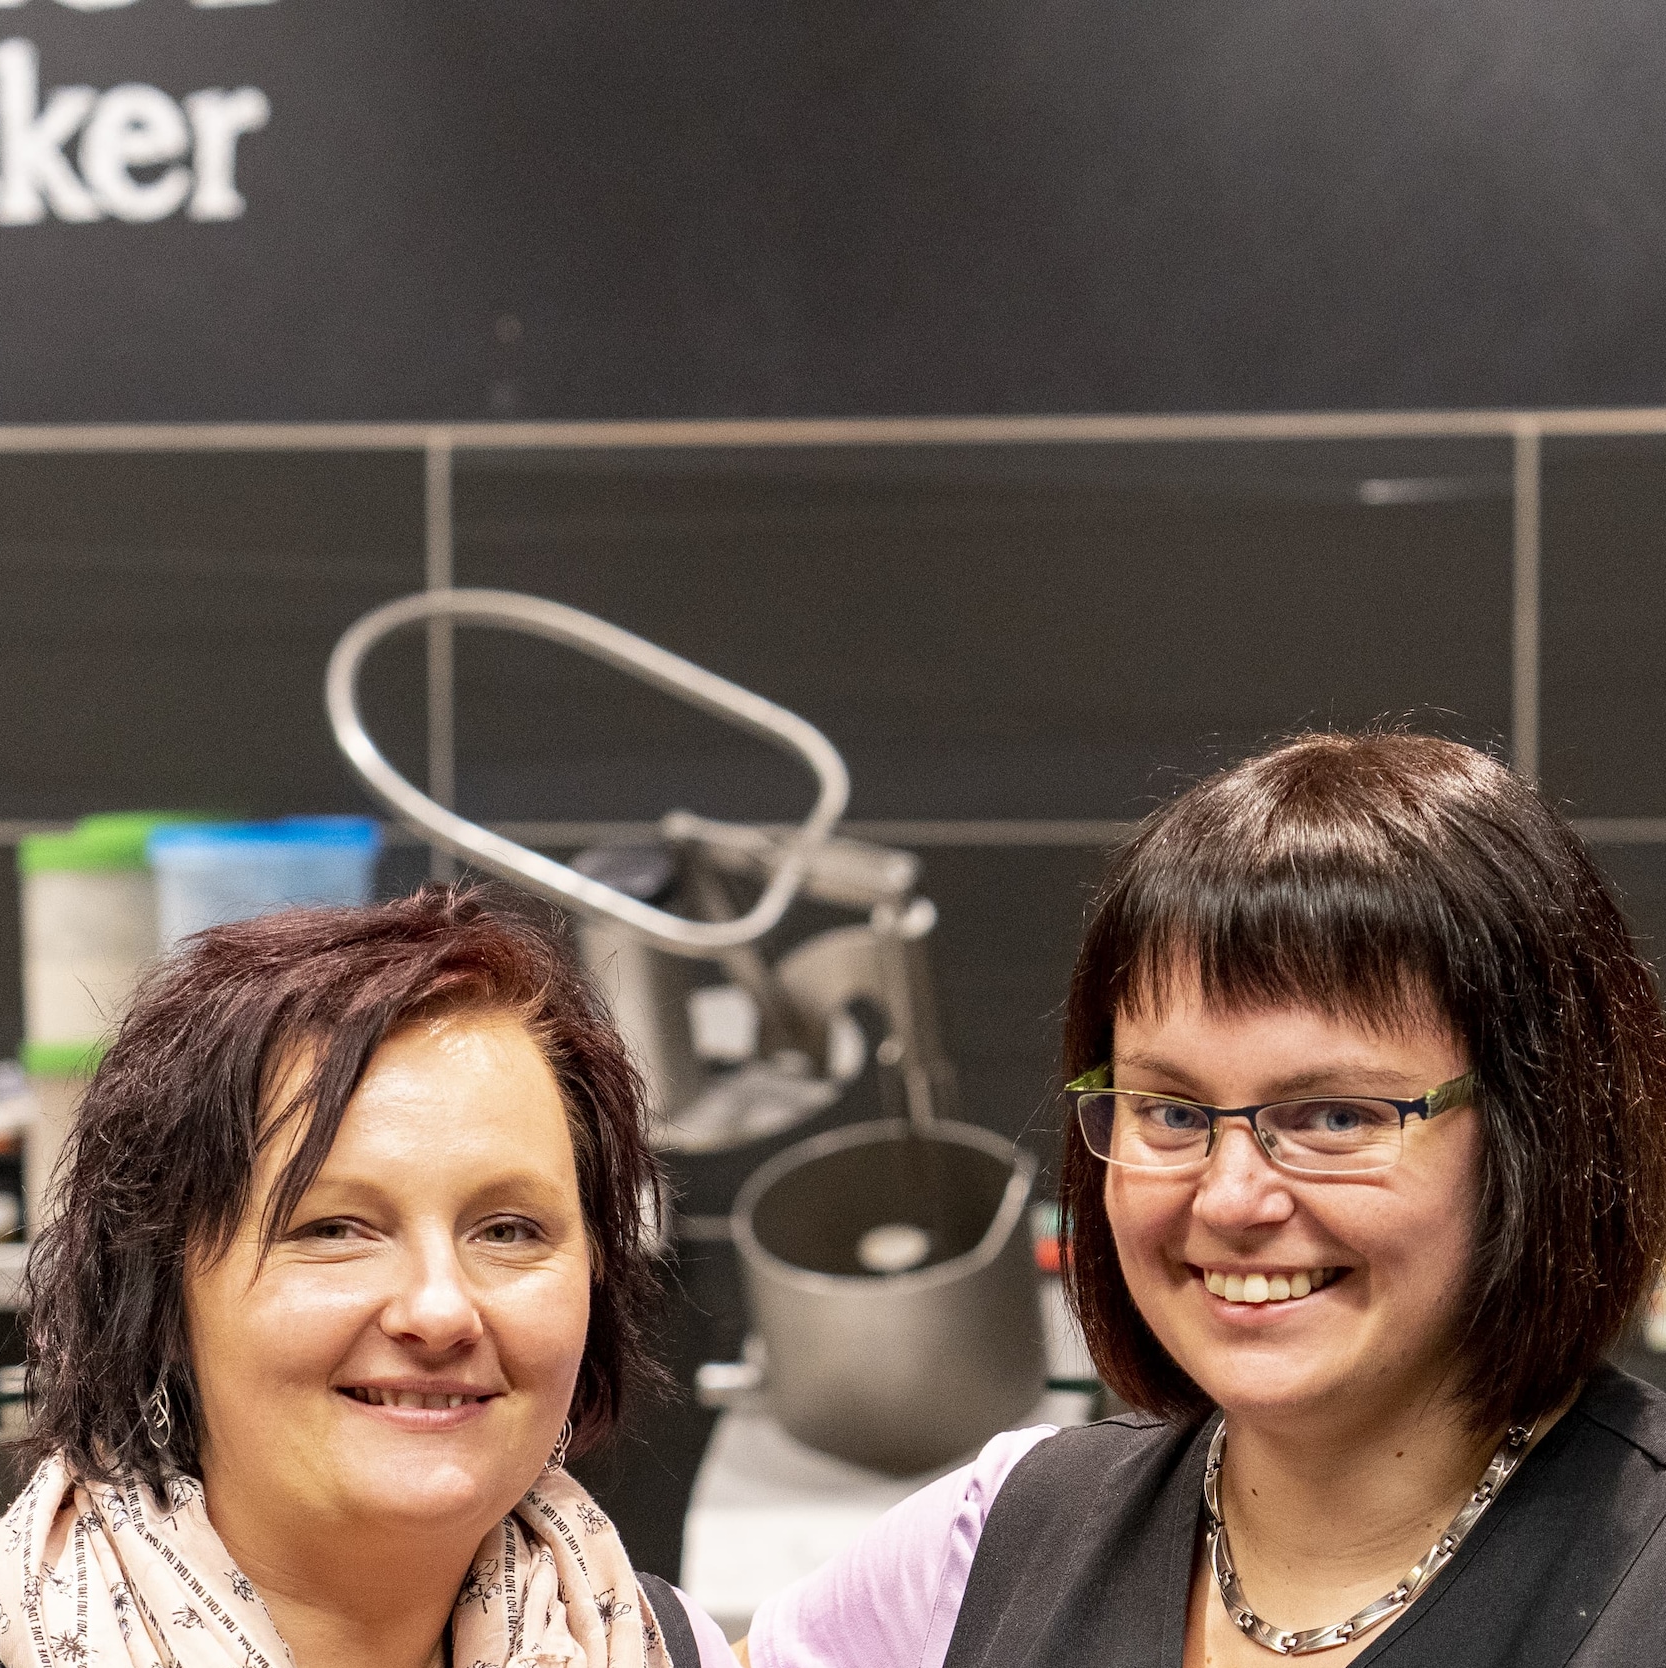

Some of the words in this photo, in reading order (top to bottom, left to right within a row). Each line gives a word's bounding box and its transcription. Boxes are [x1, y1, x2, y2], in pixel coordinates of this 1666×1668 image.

[540, 1503, 558, 1522] LOVE
[553, 1516, 570, 1536] LOVE
[565, 1534, 581, 1556] LOVE
[505, 1557, 516, 1573] LOVE
[505, 1575, 516, 1593] LOVE
[31, 1625, 45, 1646] LOVE
[38, 1648, 52, 1668] LOVE
